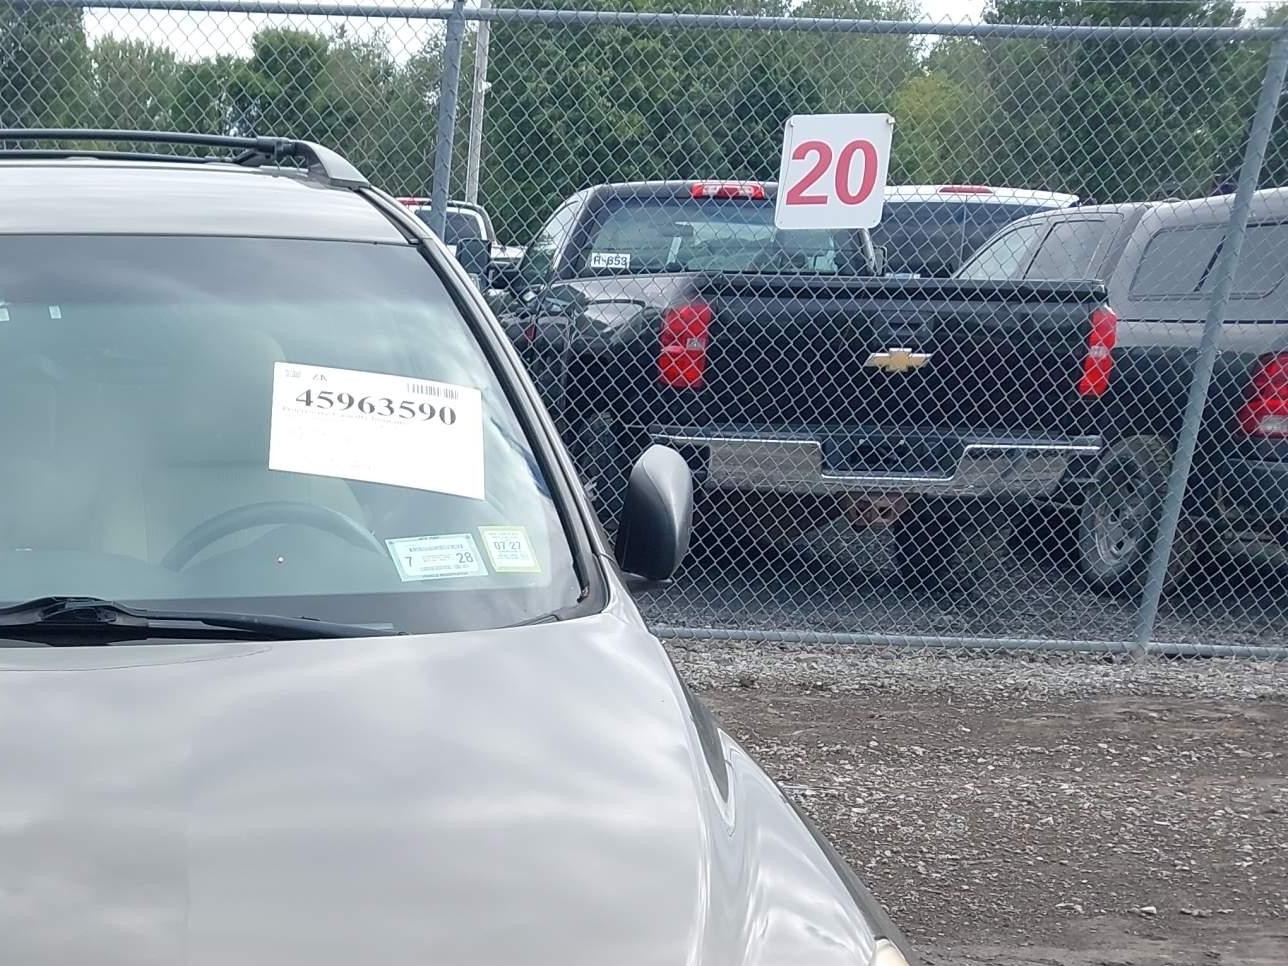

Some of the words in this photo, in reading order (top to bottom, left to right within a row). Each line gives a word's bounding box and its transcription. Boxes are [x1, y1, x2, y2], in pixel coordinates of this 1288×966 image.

[785, 140, 878, 205] 20
[295, 388, 457, 426] 45963590
[405, 556, 412, 568] 7
[455, 551, 473, 564] 28
